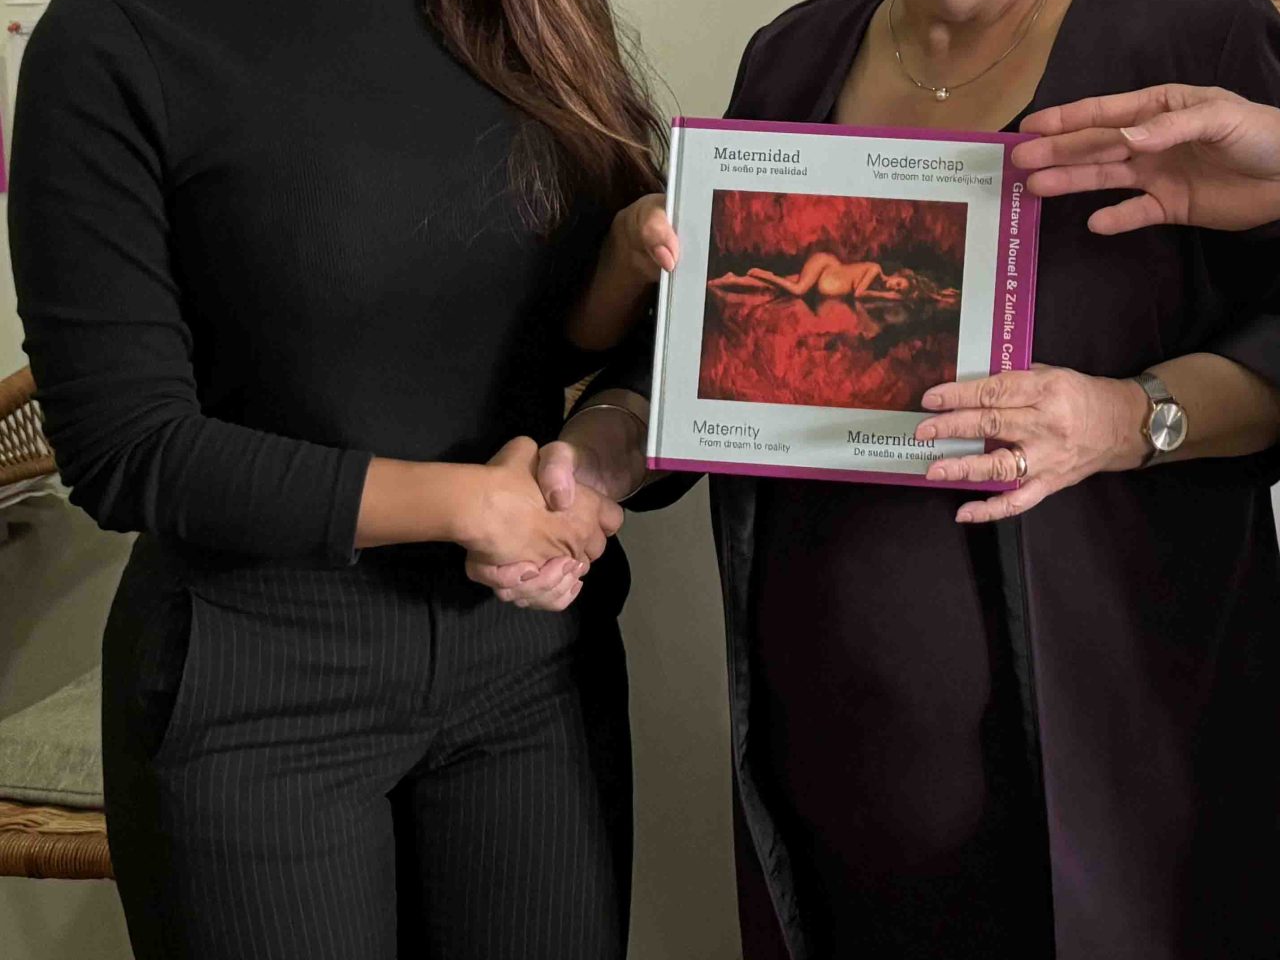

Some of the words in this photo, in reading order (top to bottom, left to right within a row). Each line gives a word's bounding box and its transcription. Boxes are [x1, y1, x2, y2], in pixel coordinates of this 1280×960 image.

[714, 146, 801, 164] Maternidad
[866, 153, 964, 174] Moederschap
[720, 163, 730, 172] Di
[732, 165, 754, 173] soño
[756, 167, 767, 175] pa
[770, 166, 808, 176] realidad
[873, 170, 889, 180] Van
[891, 170, 919, 181] droom
[922, 172, 934, 182] tot
[1010, 182, 1024, 235] Gustave
[1007, 237, 1020, 277] Nouel
[1006, 281, 1018, 291] &
[1003, 293, 1016, 341] Zuleika
[693, 419, 760, 440] Maternity
[699, 437, 721, 447] From
[723, 440, 751, 449] dream
[753, 441, 763, 450] to
[764, 442, 791, 453] reality
[854, 447, 865, 456] De
